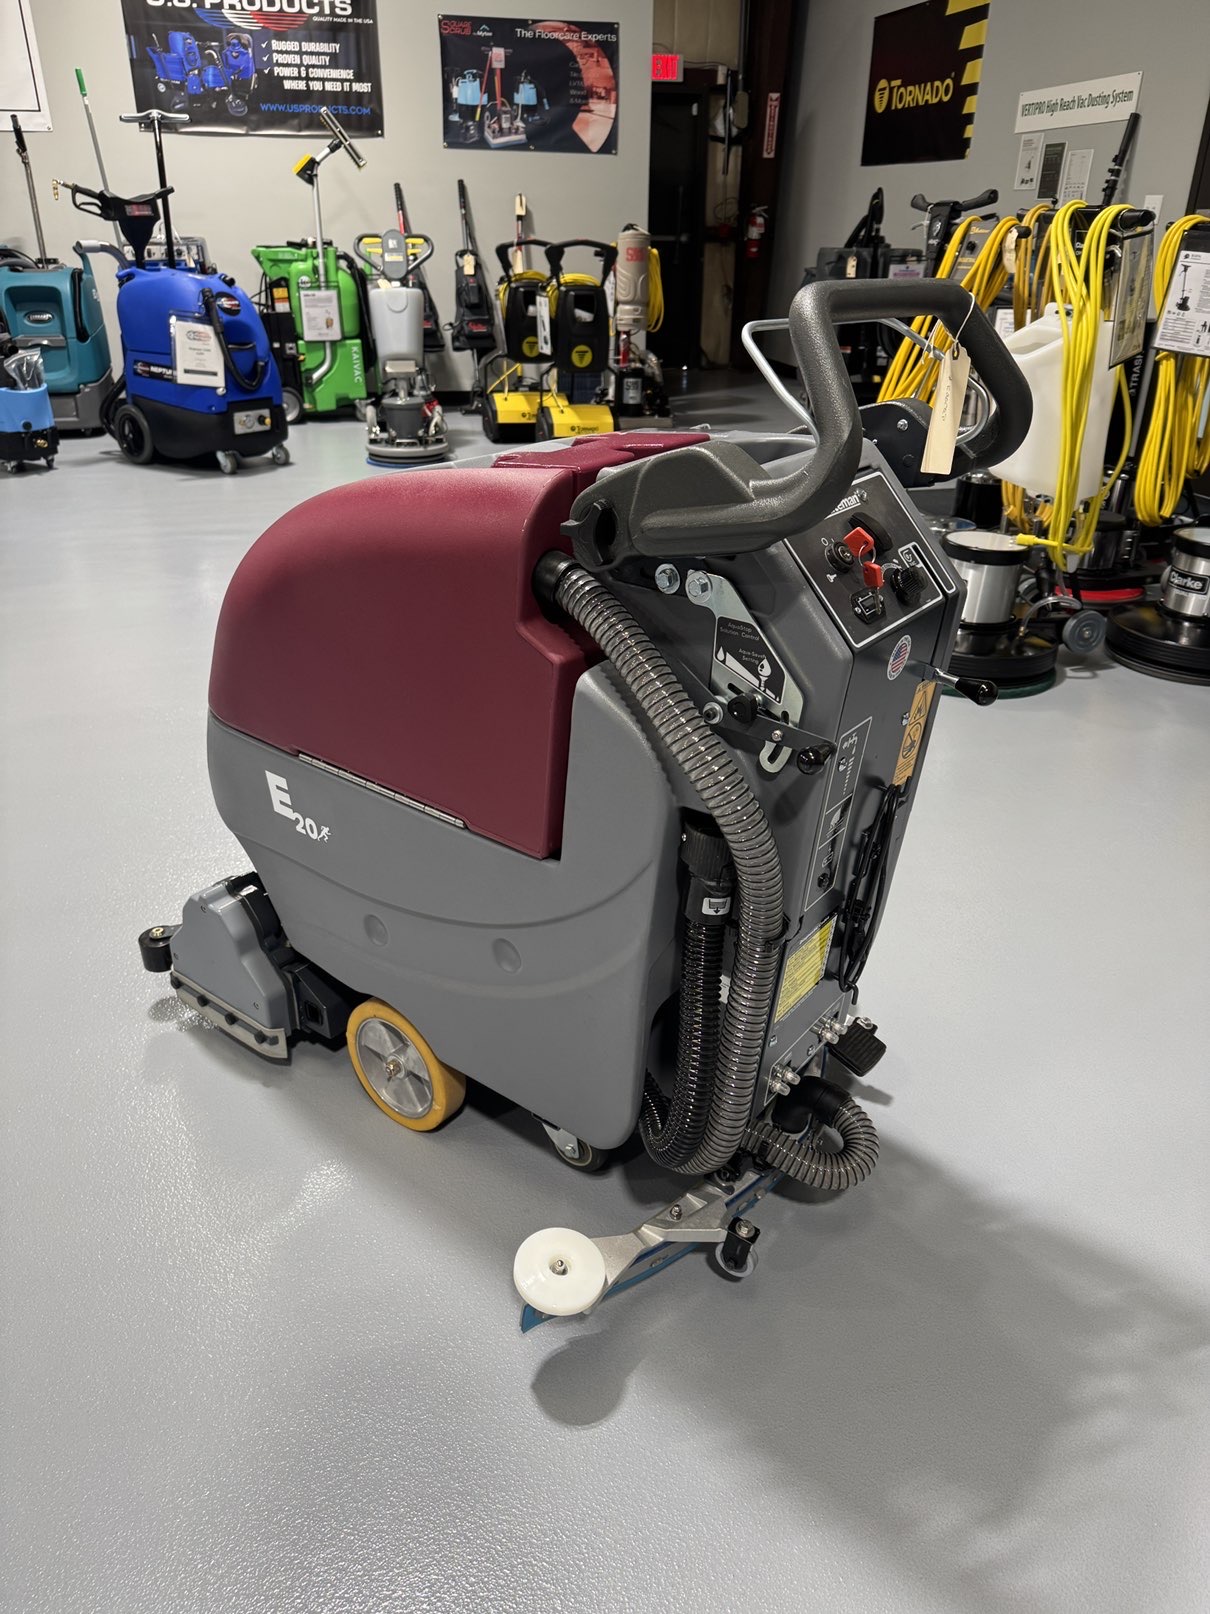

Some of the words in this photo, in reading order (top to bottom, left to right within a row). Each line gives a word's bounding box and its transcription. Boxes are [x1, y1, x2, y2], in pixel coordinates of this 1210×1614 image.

[515, 27, 534, 38] The
[535, 30, 580, 41] Floorcare
[581, 31, 617, 42] Experts
[271, 40, 299, 51] RUGGED
[301, 42, 340, 53] DURABILITY
[272, 53, 301, 64] PROVEN
[302, 55, 330, 65] QUALITY
[273, 66, 299, 77] POWER
[300, 67, 307, 77] &
[308, 68, 354, 79] CONVENIENCE
[283, 79, 307, 91] WHERE
[308, 81, 323, 91] YOU
[324, 82, 342, 92] NEED
[343, 83, 351, 92] IT
[352, 83, 372, 93] MOST
[890, 78, 954, 110] TORNADO
[260, 103, 371, 115] WWW.USPROCTS.COM
[1021, 101, 1046, 117] VERTIPRO
[1046, 99, 1059, 116] High
[1059, 96, 1076, 112] Reach
[1076, 95, 1087, 109] Vac
[1087, 91, 1111, 109] Dusting
[1111, 89, 1134, 107] System
[351, 346, 363, 384] KAIVAC
[1170, 571, 1203, 590] Clarke
[741, 632, 760, 641] Control
